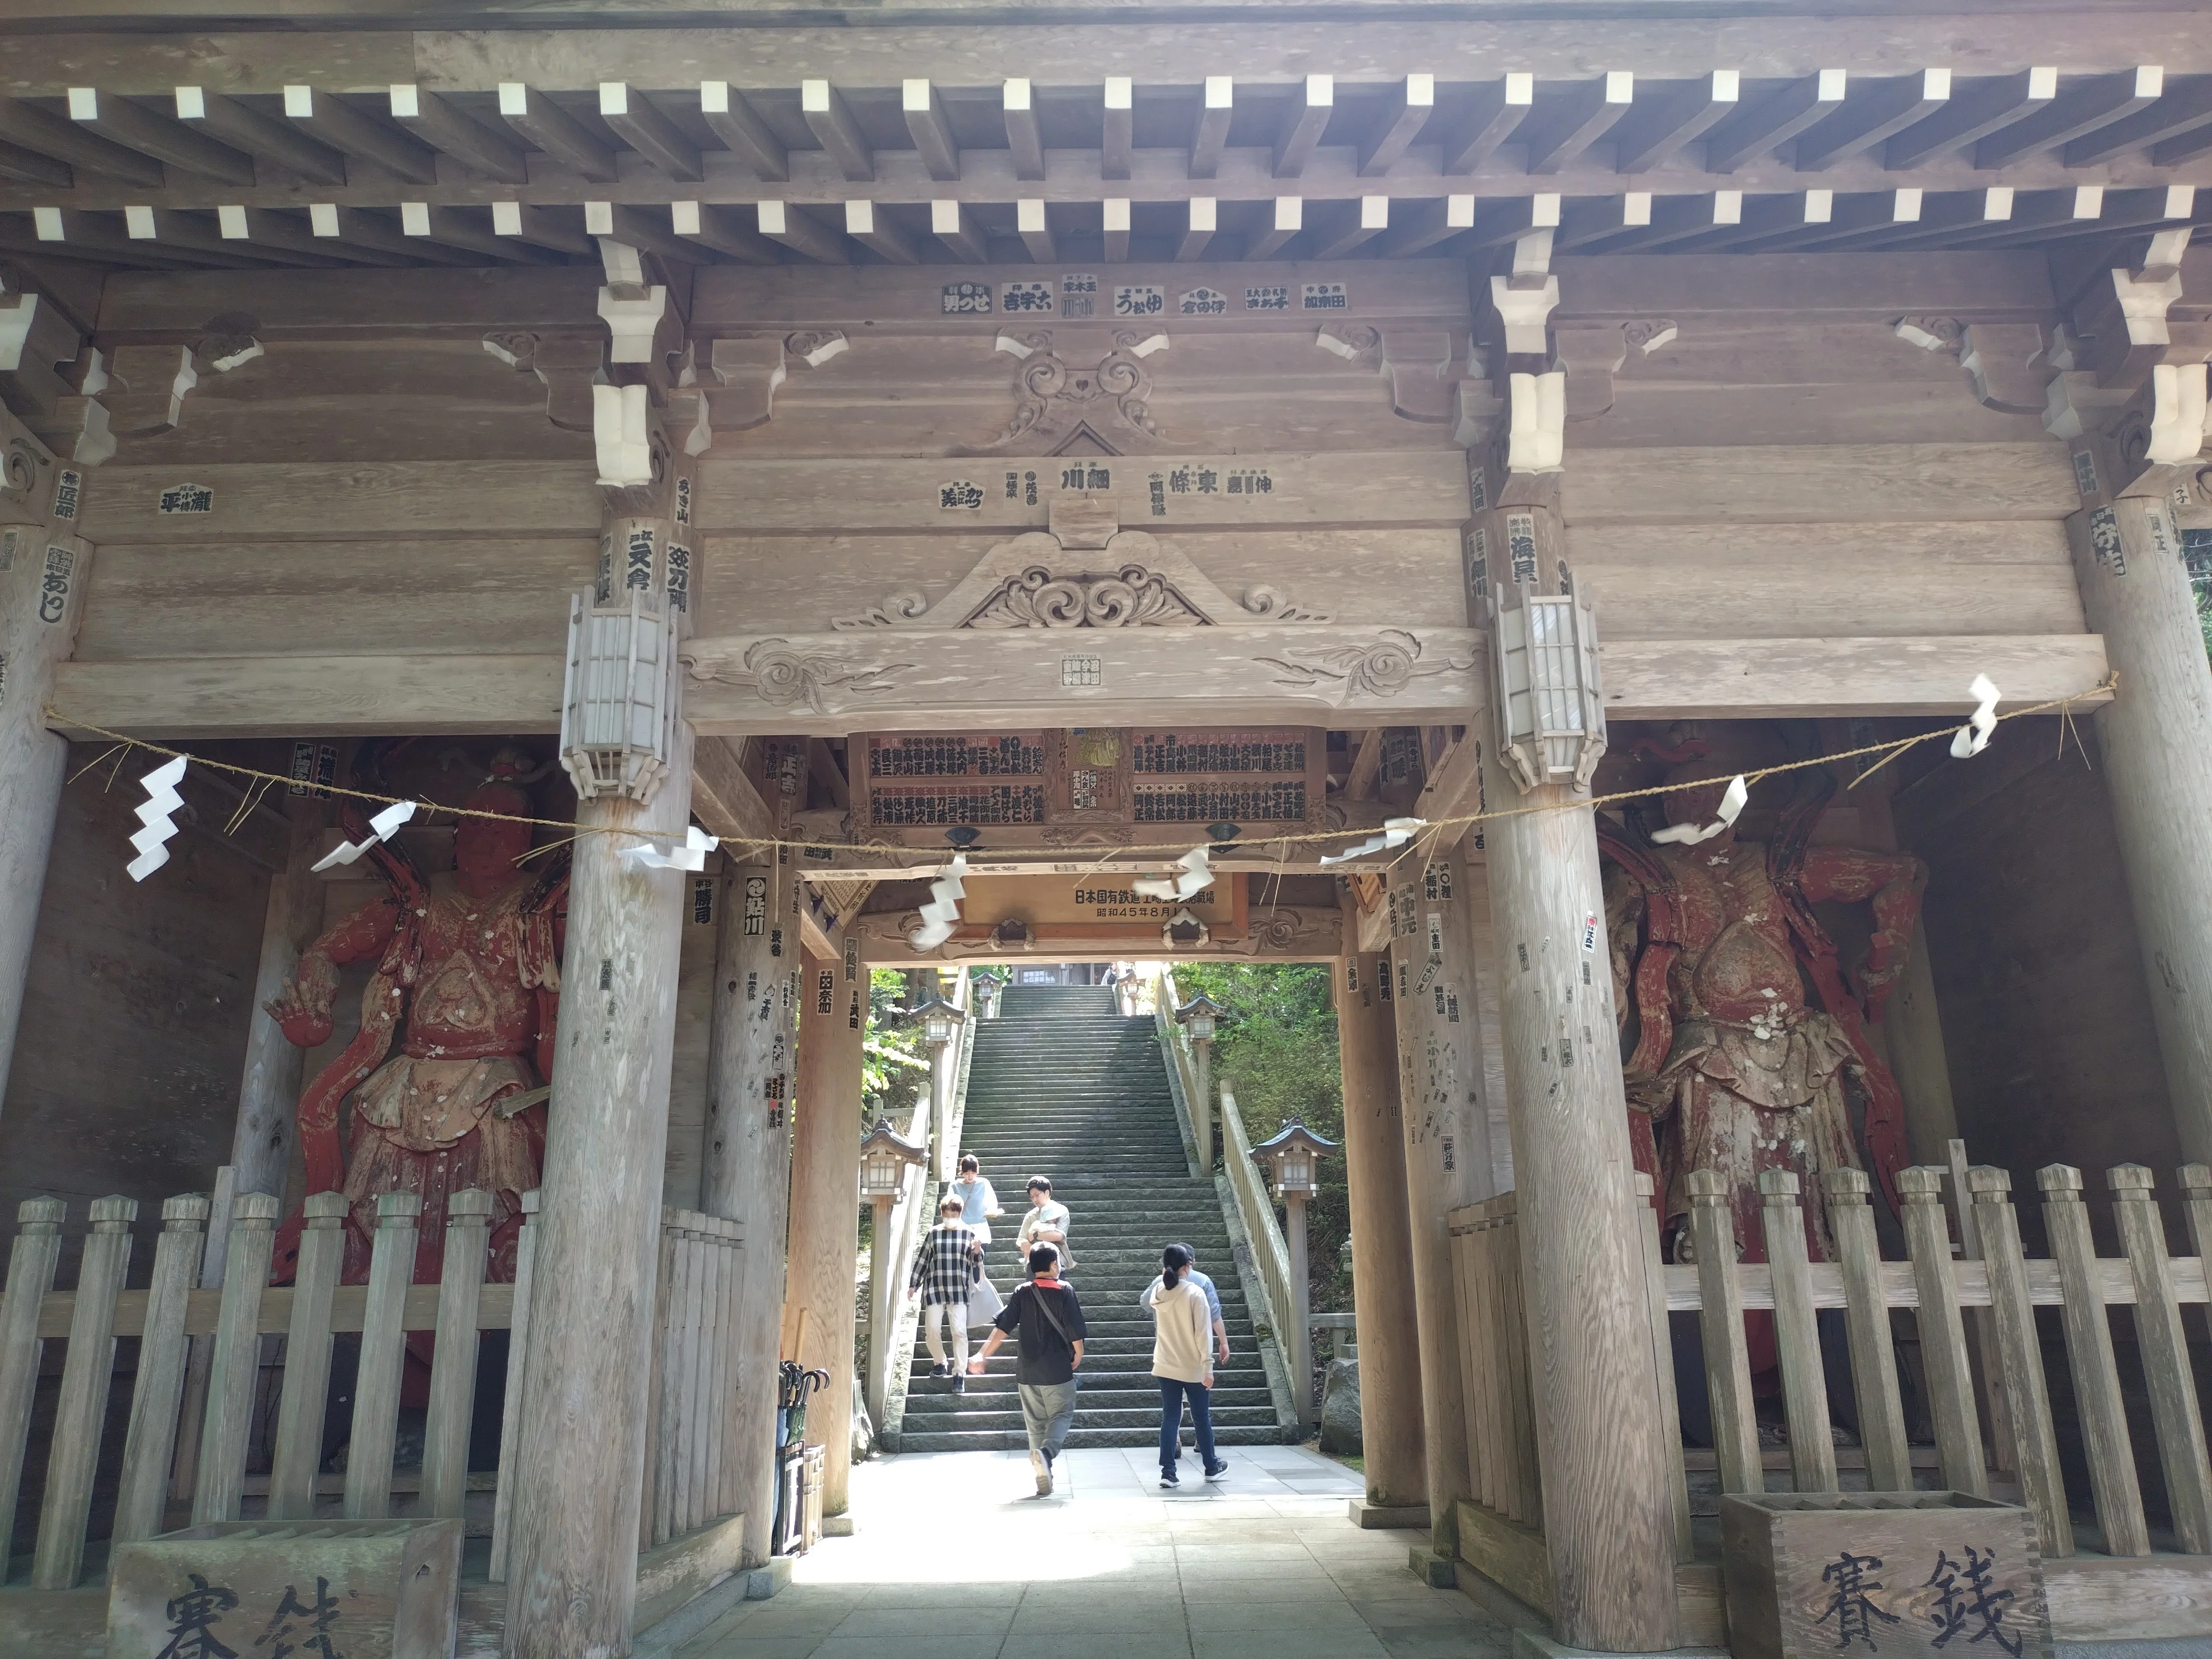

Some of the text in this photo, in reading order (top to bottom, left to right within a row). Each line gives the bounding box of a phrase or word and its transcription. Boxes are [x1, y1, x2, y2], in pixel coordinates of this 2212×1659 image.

[1062, 468, 1110, 489] 細川
[1075, 889, 1141, 904] 日本国有鉄道
[1097, 907, 1190, 917] 昭和45年8月1
